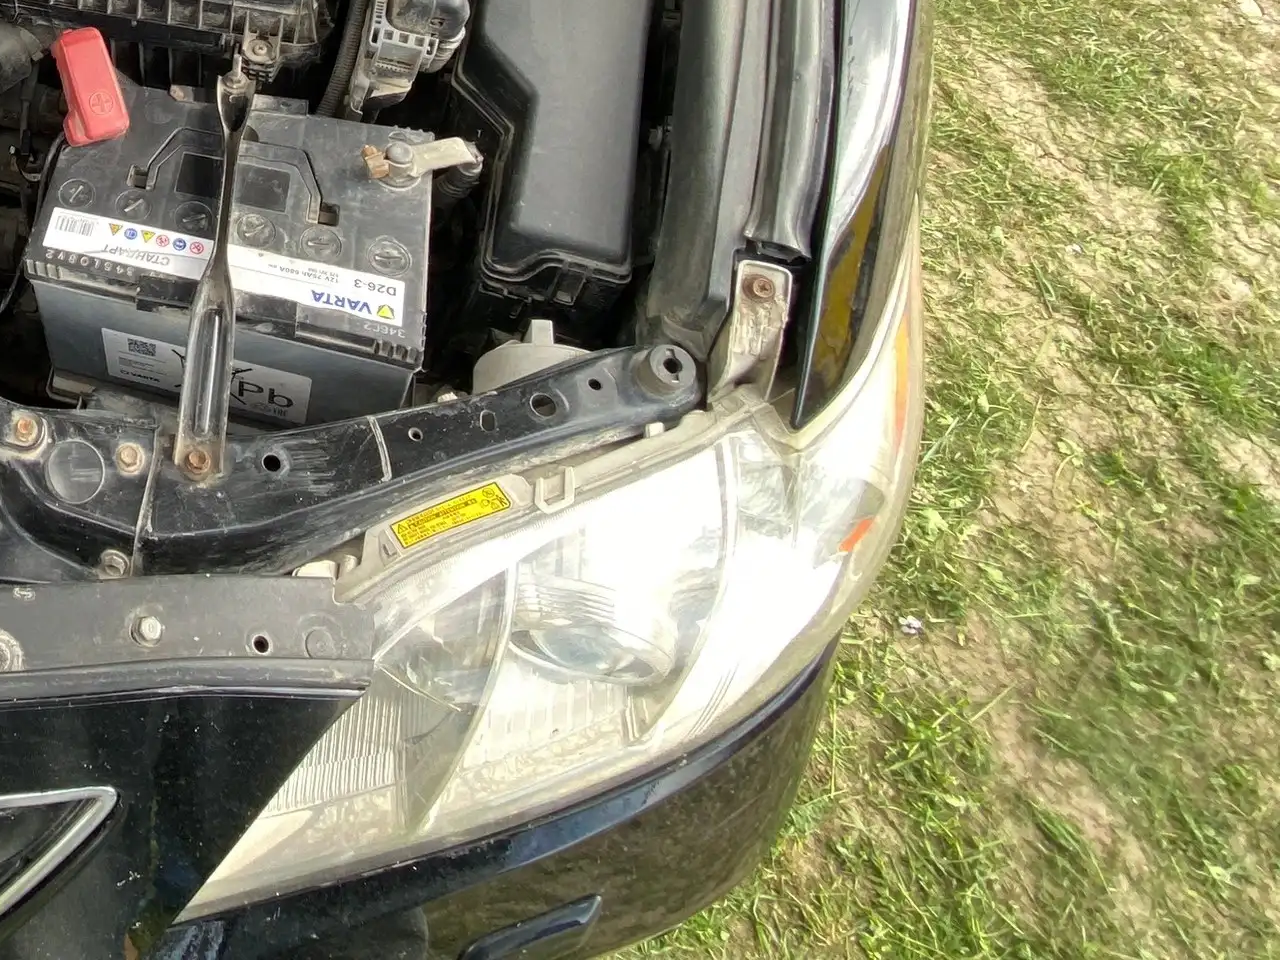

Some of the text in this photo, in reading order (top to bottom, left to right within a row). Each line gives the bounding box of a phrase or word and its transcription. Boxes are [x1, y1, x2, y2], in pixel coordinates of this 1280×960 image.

[100, 244, 171, 267] СТАНДАРТ
[352, 278, 397, 297] D26-3
[311, 289, 372, 315] VARTA
[237, 378, 295, 408] Pb
